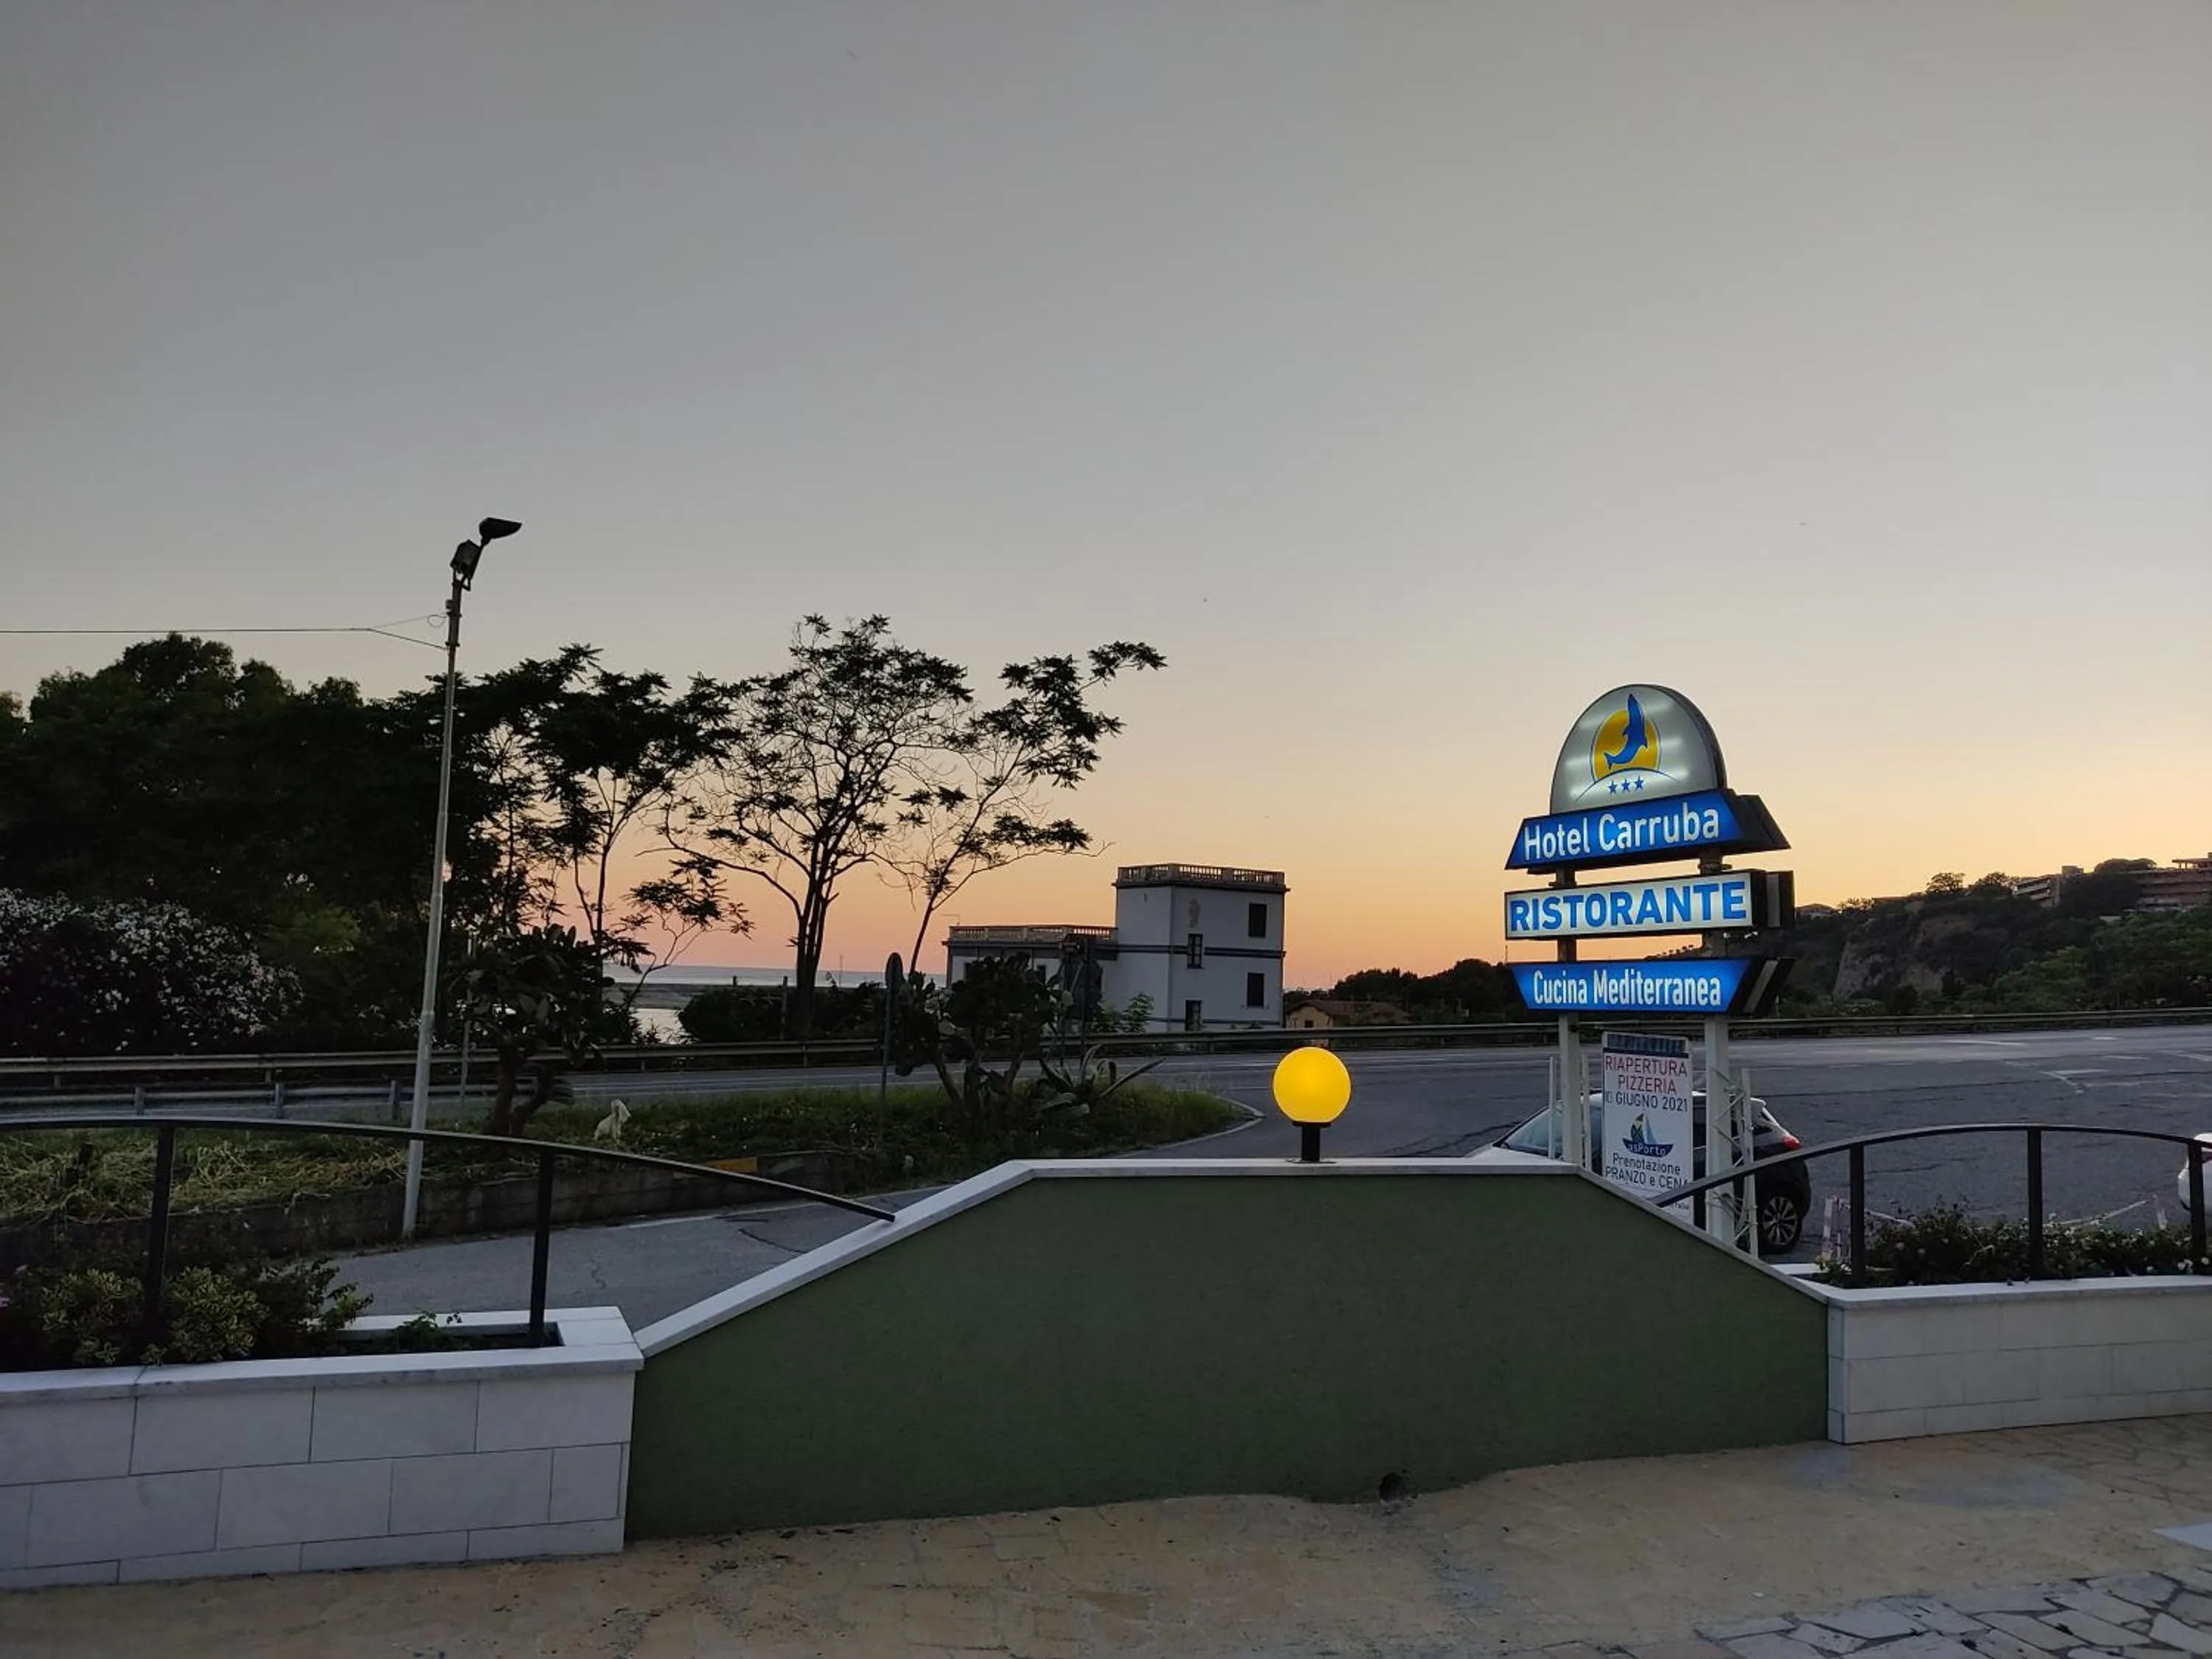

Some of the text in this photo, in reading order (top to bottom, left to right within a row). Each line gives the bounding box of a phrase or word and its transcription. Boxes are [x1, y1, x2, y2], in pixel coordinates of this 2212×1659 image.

[1523, 801, 1719, 860] Hotel Carruba
[1510, 880, 1747, 931] RISTORANTE
[1534, 968, 1721, 1006] Cucina Mediterranea
[1605, 1055, 1688, 1077] RIAPERTURA
[1618, 1075, 1677, 1094] PIZZERIA
[1615, 1092, 1658, 1109] GIUGNO
[1663, 1096, 1688, 1113] 2021
[1613, 1152, 1681, 1175] Prenotazione
[1605, 1166, 1646, 1185] PRANZO
[1649, 1176, 1655, 1186] e
